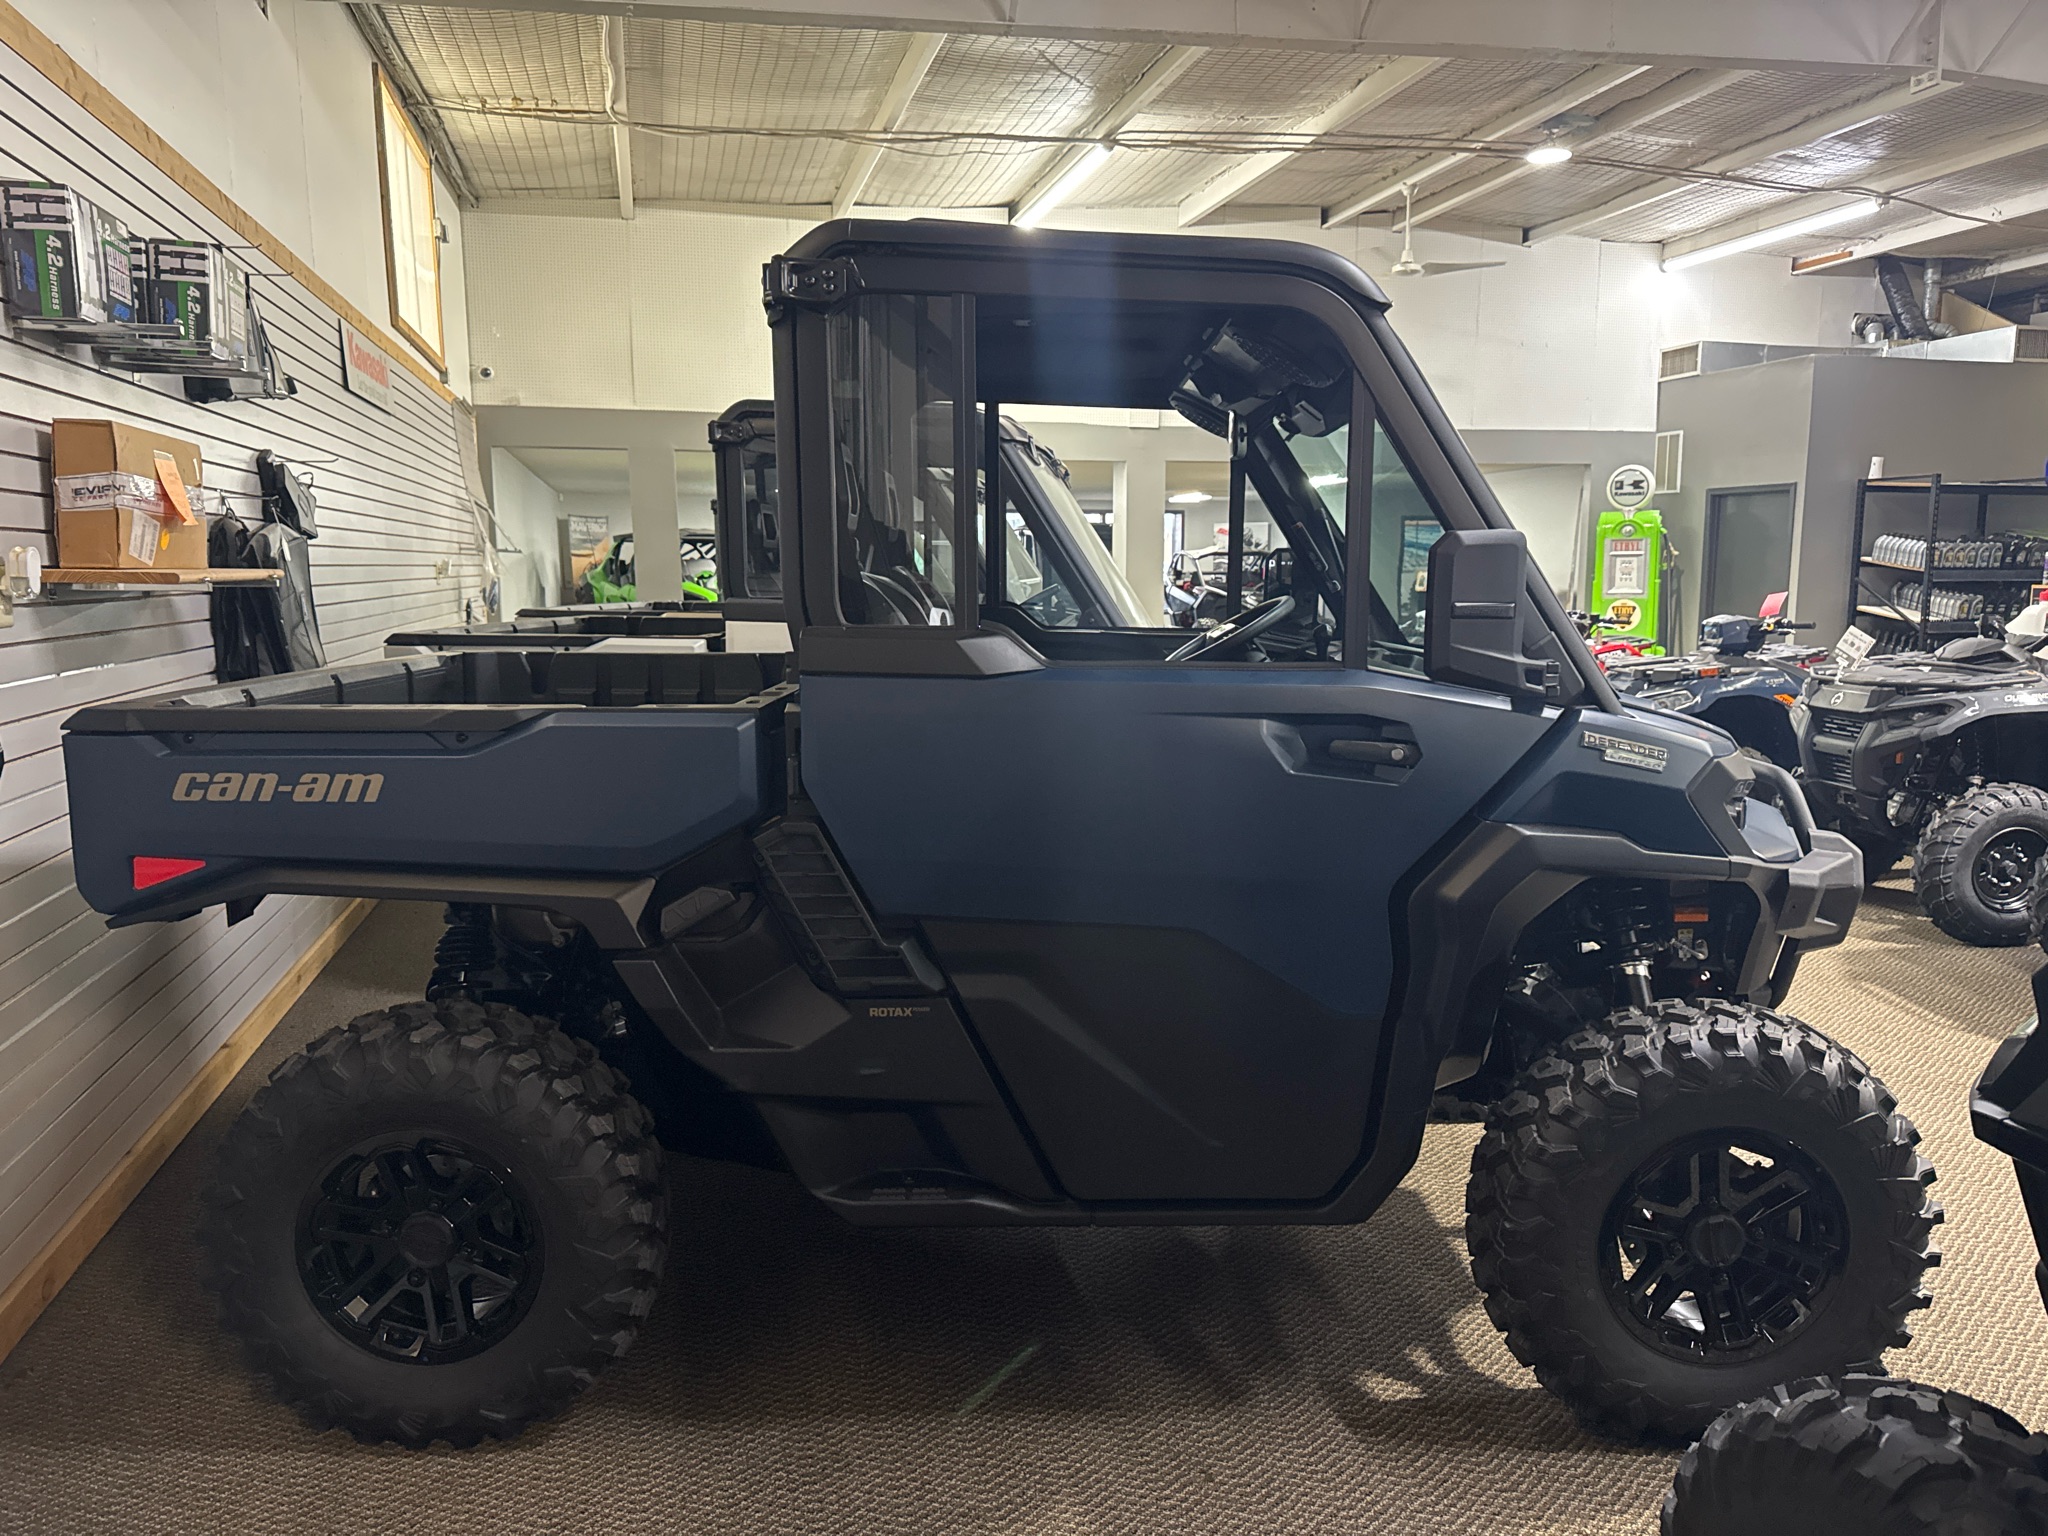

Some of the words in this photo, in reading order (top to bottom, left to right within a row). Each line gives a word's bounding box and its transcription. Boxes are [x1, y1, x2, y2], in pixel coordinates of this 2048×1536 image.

[45, 234, 64, 268] 4.2
[48, 266, 61, 311] Harness
[187, 285, 201, 314] 4.2
[187, 312, 197, 340] Harne
[346, 327, 390, 389] Kawasaki
[1613, 541, 1642, 551] ETHYL
[1613, 606, 1635, 615] ETHYL
[1587, 735, 1667, 761] DEFENDER
[172, 772, 385, 803] can-am
[869, 1007, 913, 1017] ROTAX
